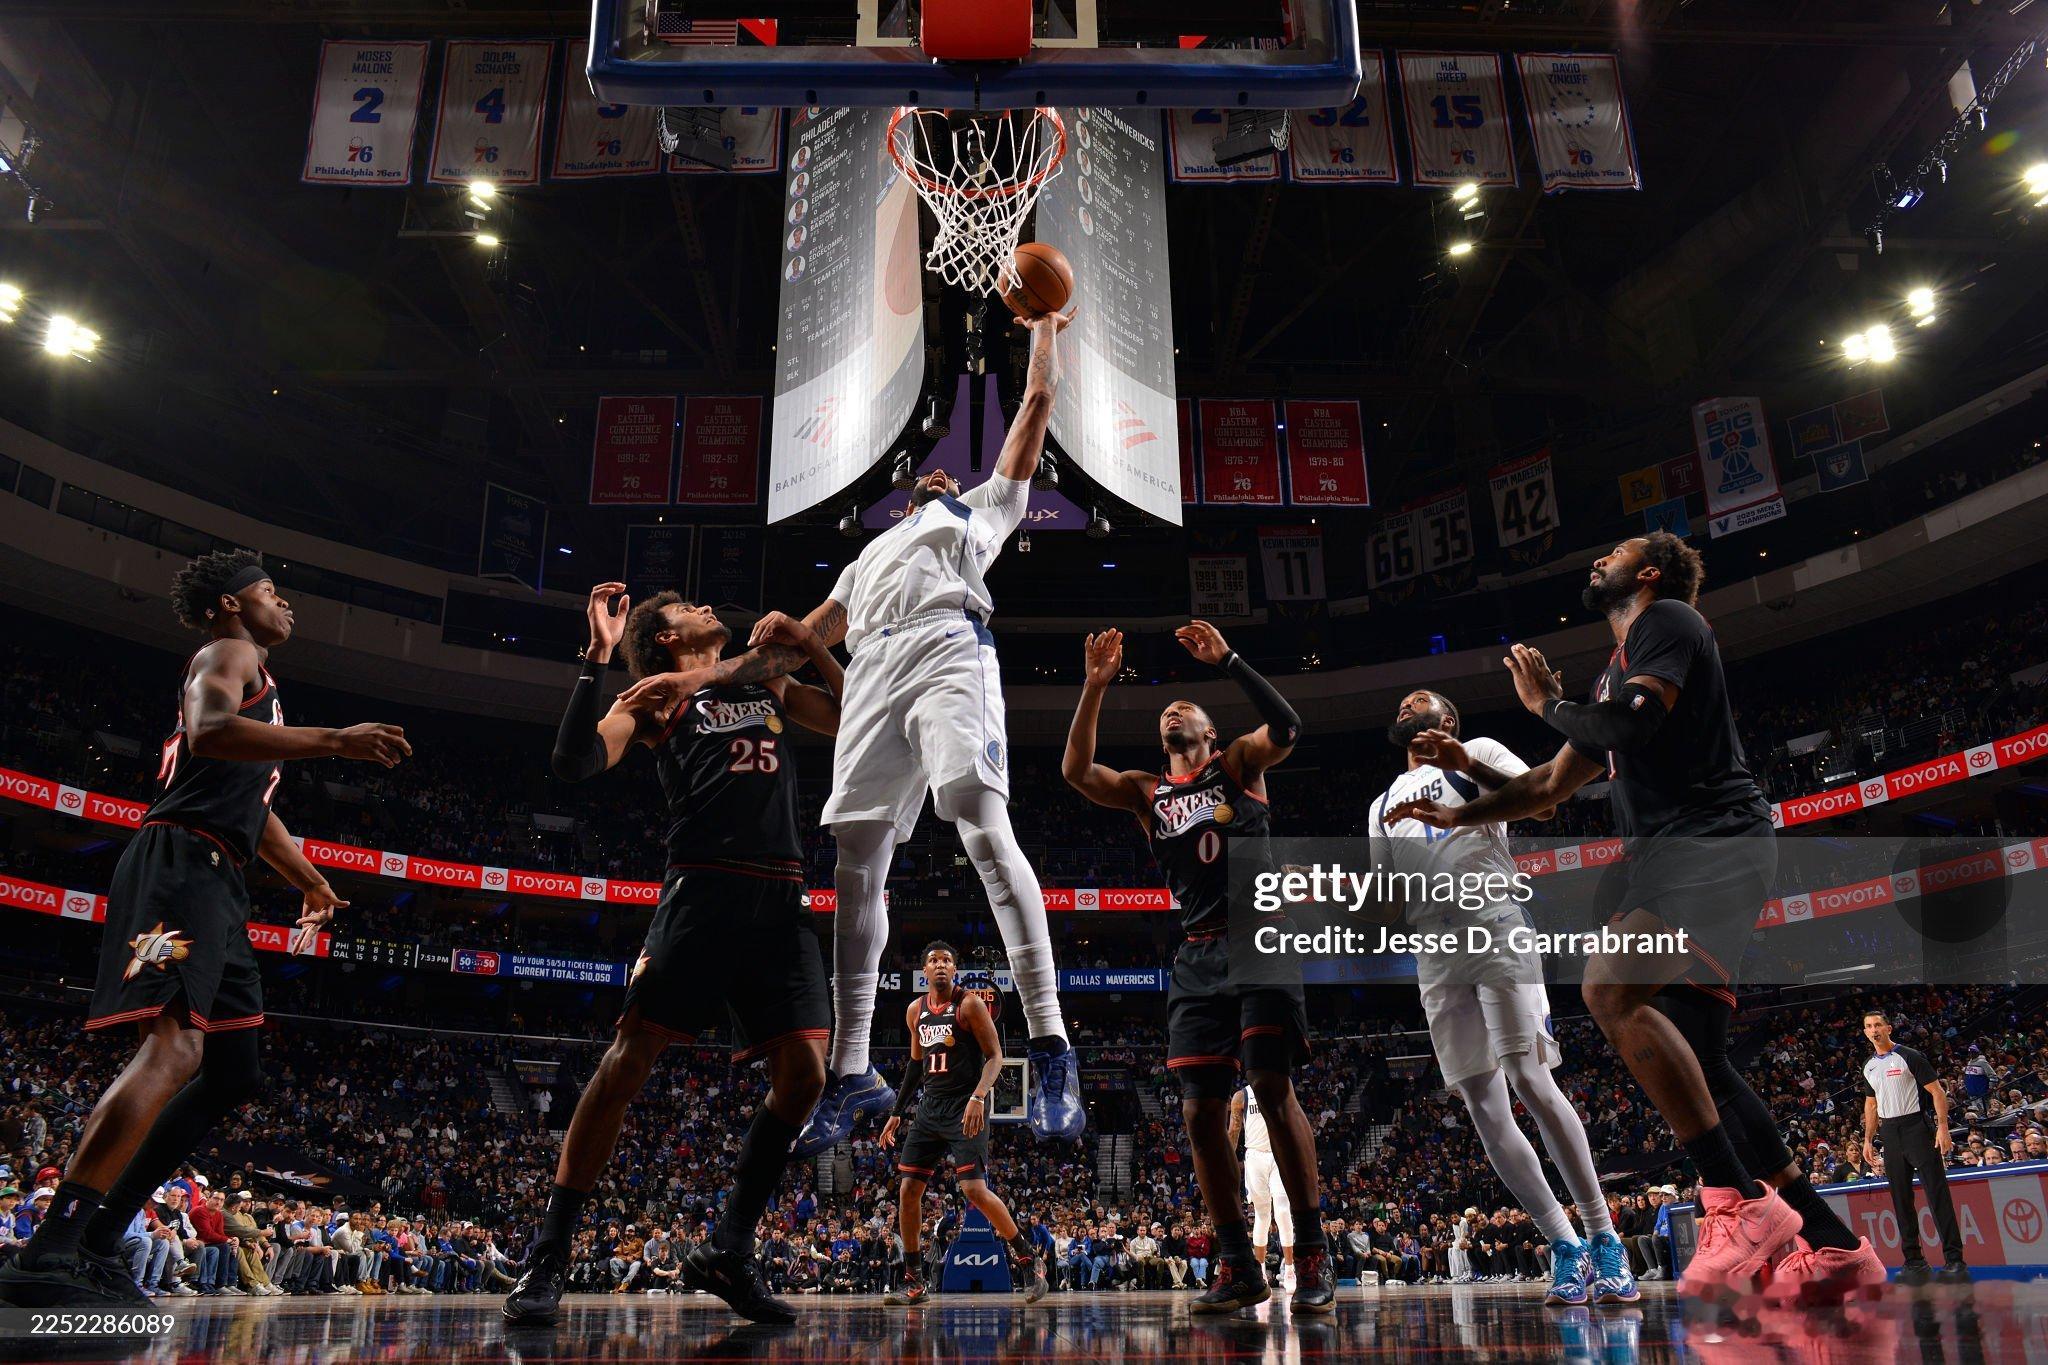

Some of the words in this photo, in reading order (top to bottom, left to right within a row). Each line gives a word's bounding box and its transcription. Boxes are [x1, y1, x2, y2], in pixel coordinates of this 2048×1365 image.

[357, 51, 392, 62] MOSES
[482, 51, 516, 62] DOLPH
[352, 63, 393, 74] MALONE
[474, 63, 521, 75] SCHAYES
[1440, 61, 1460, 72] HAL
[1551, 62, 1581, 74] DAVID
[1436, 72, 1468, 83] GREER
[350, 87, 384, 123] 2
[474, 88, 506, 124] 4
[1430, 95, 1485, 129] 15
[801, 107, 850, 146] PHILADELPHIA
[1113, 115, 1155, 152] MAVERICKS
[597, 138, 622, 156] 76
[813, 133, 836, 152] MAXEY
[348, 146, 373, 162] 76
[474, 146, 498, 163] 76
[1329, 147, 1354, 163] 76
[1450, 150, 1476, 165] 76
[1567, 148, 1594, 165] 76
[315, 166, 374, 177] Philadelphia
[376, 168, 402, 177] 76ers
[564, 160, 622, 170] Philadelphia
[812, 149, 848, 178] DRUMMOND
[1184, 165, 1242, 174] Philadelphia
[1301, 168, 1360, 177] Philadelphia
[1362, 168, 1387, 176] 76ers
[1483, 171, 1507, 179] 76ers
[1544, 170, 1600, 180] Philadelphia
[1601, 169, 1626, 177] 76ers
[811, 180, 841, 205] EDWARDS
[1094, 196, 1123, 224] MARSHALL
[810, 211, 836, 232] BARLOW
[808, 234, 844, 263] EDGECOMBE
[814, 271, 832, 287] TEAM
[831, 256, 851, 277] STATS
[1101, 259, 1118, 276] TEAM
[1118, 272, 1138, 290] STATS
[807, 327, 826, 343] TEAM
[826, 310, 852, 331] LEADERS
[1117, 323, 1144, 346] LEADERS
[787, 356, 799, 367] STL
[786, 370, 799, 382] BLK
[1229, 408, 1248, 417] NBA
[1313, 408, 1331, 418] NBA
[1719, 402, 1750, 417] TOYOTA
[1220, 417, 1259, 427] EASTERN
[1304, 418, 1343, 428] EASTERN
[1706, 412, 1753, 439] BIG
[1214, 428, 1265, 437] CONFERENCE
[1298, 428, 1351, 439] CONFERENCE
[1216, 437, 1265, 447] CHAMPIONS
[1301, 439, 1349, 448] CHAMPIONS
[1224, 455, 1260, 466] 1976-77
[1309, 456, 1345, 467] 1979-80
[775, 471, 806, 493] BANK
[808, 464, 823, 477] OF
[1126, 463, 1175, 495] AMERICA
[1233, 477, 1253, 491] 76
[1319, 478, 1338, 492] 76
[1299, 494, 1341, 502] Philadelphia
[1502, 479, 1551, 538] 42
[1737, 509, 1782, 527] CHAMPIONS
[1428, 512, 1468, 566] 35
[1373, 530, 1414, 582] 66
[1276, 551, 1311, 595] 11
[2001, 729, 2048, 760] TOYO
[729, 739, 780, 773] 25
[1891, 762, 1961, 793] TOYOTA
[0, 773, 51, 802] YOTA
[1787, 791, 1857, 820] TOYOTA
[1197, 830, 1221, 864] 0
[310, 844, 375, 868] TOYOTA
[413, 861, 476, 883] TOYOTA
[1923, 858, 1998, 887] TOYOTA
[514, 875, 576, 894] TOYOTA
[1104, 893, 1165, 906] TOYOTA
[1817, 883, 1887, 910] TOYOTA
[333, 950, 349, 959] DAL
[335, 942, 349, 950] PHI
[420, 953, 436, 963] 7:53
[459, 957, 472, 966] 50
[483, 959, 496, 968] 50
[512, 955, 526, 964] BUY
[527, 956, 545, 966] YOUR
[567, 960, 593, 970] TICKETS
[594, 962, 613, 972] NOW!
[513, 965, 551, 978] CURRENT
[552, 968, 579, 980] TOTAL:
[579, 970, 611, 983] $10,050
[878, 973, 902, 991] 45
[1069, 974, 1101, 986] DALLAS
[1105, 973, 1155, 986] MAVERICKS
[928, 1052, 949, 1073] 11
[1861, 1203, 1985, 1249] TOOA
[953, 1253, 999, 1266] KIA
